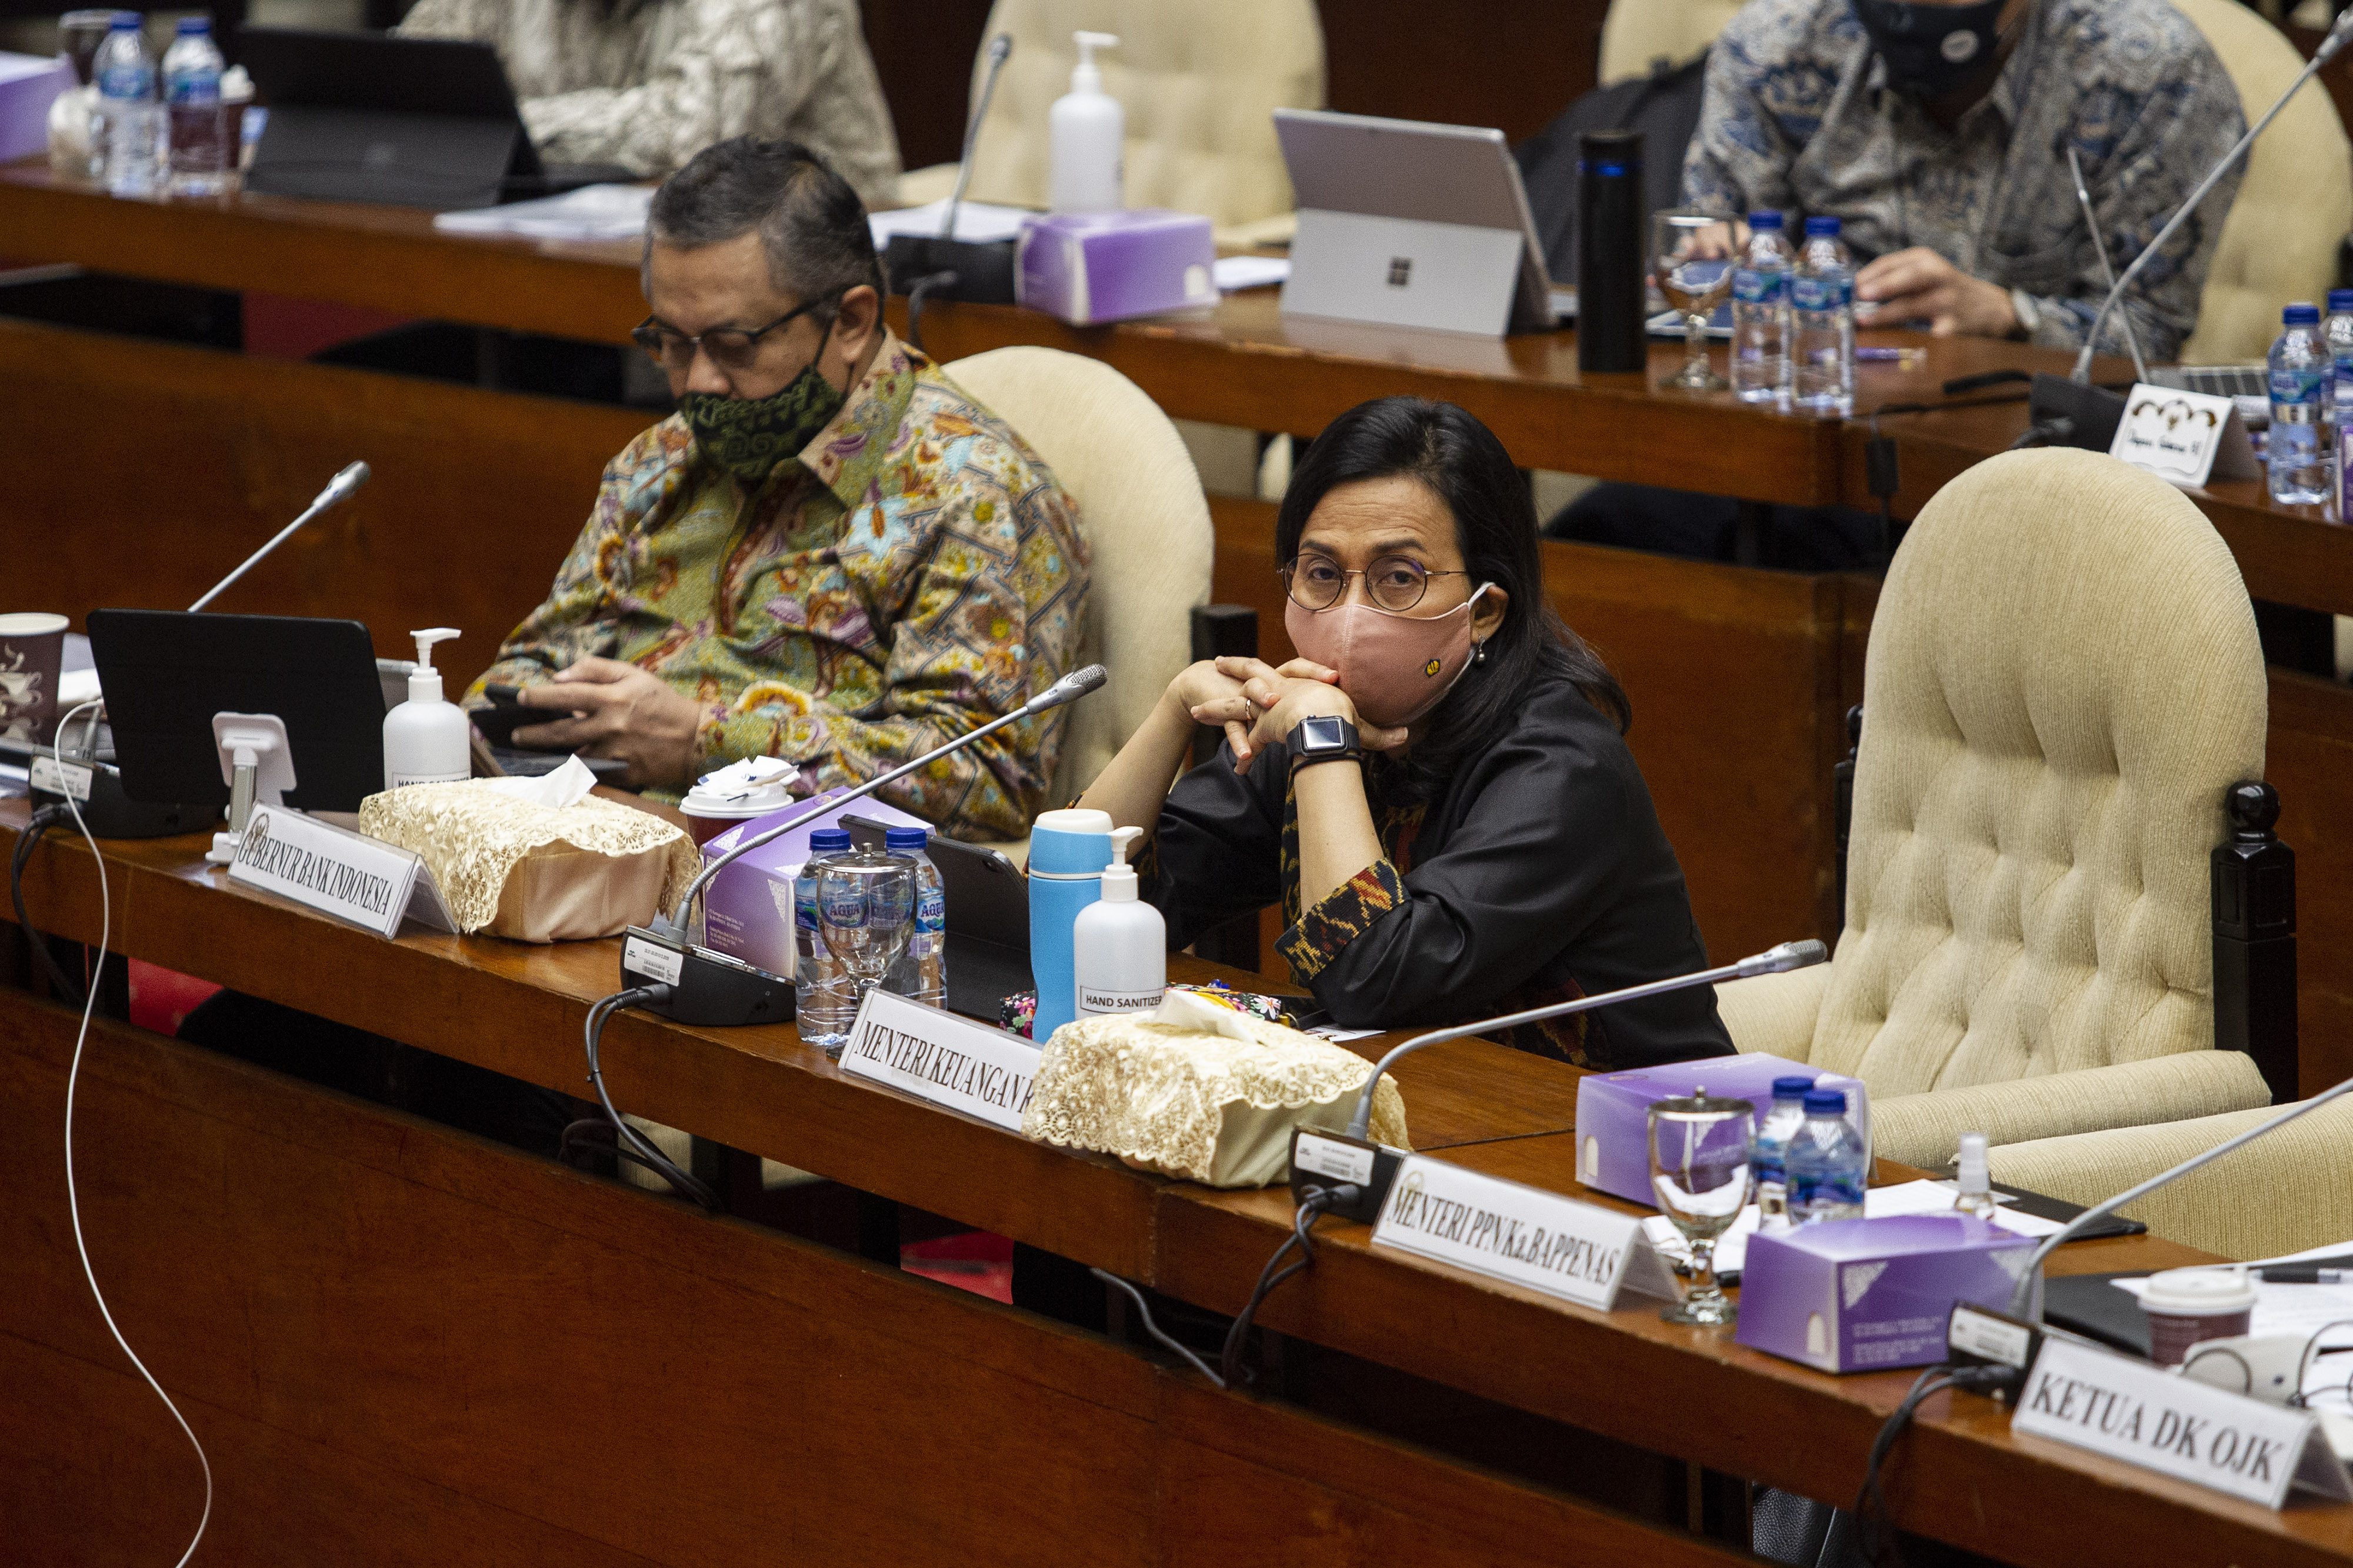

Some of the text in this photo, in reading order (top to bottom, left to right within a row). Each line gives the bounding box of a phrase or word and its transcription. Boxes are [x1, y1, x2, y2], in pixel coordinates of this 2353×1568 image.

[238, 830, 394, 916] GUBERNUR BANK INDONESIA
[829, 904, 860, 919] AQUA
[1086, 995, 1162, 1007] HAND SANITIZER
[854, 1020, 935, 1077] MENTERI
[928, 1046, 1026, 1111] KEUANGAN
[1387, 1186, 1472, 1242] MENTERI
[2031, 1372, 2285, 1483] KETUA DK OJK
